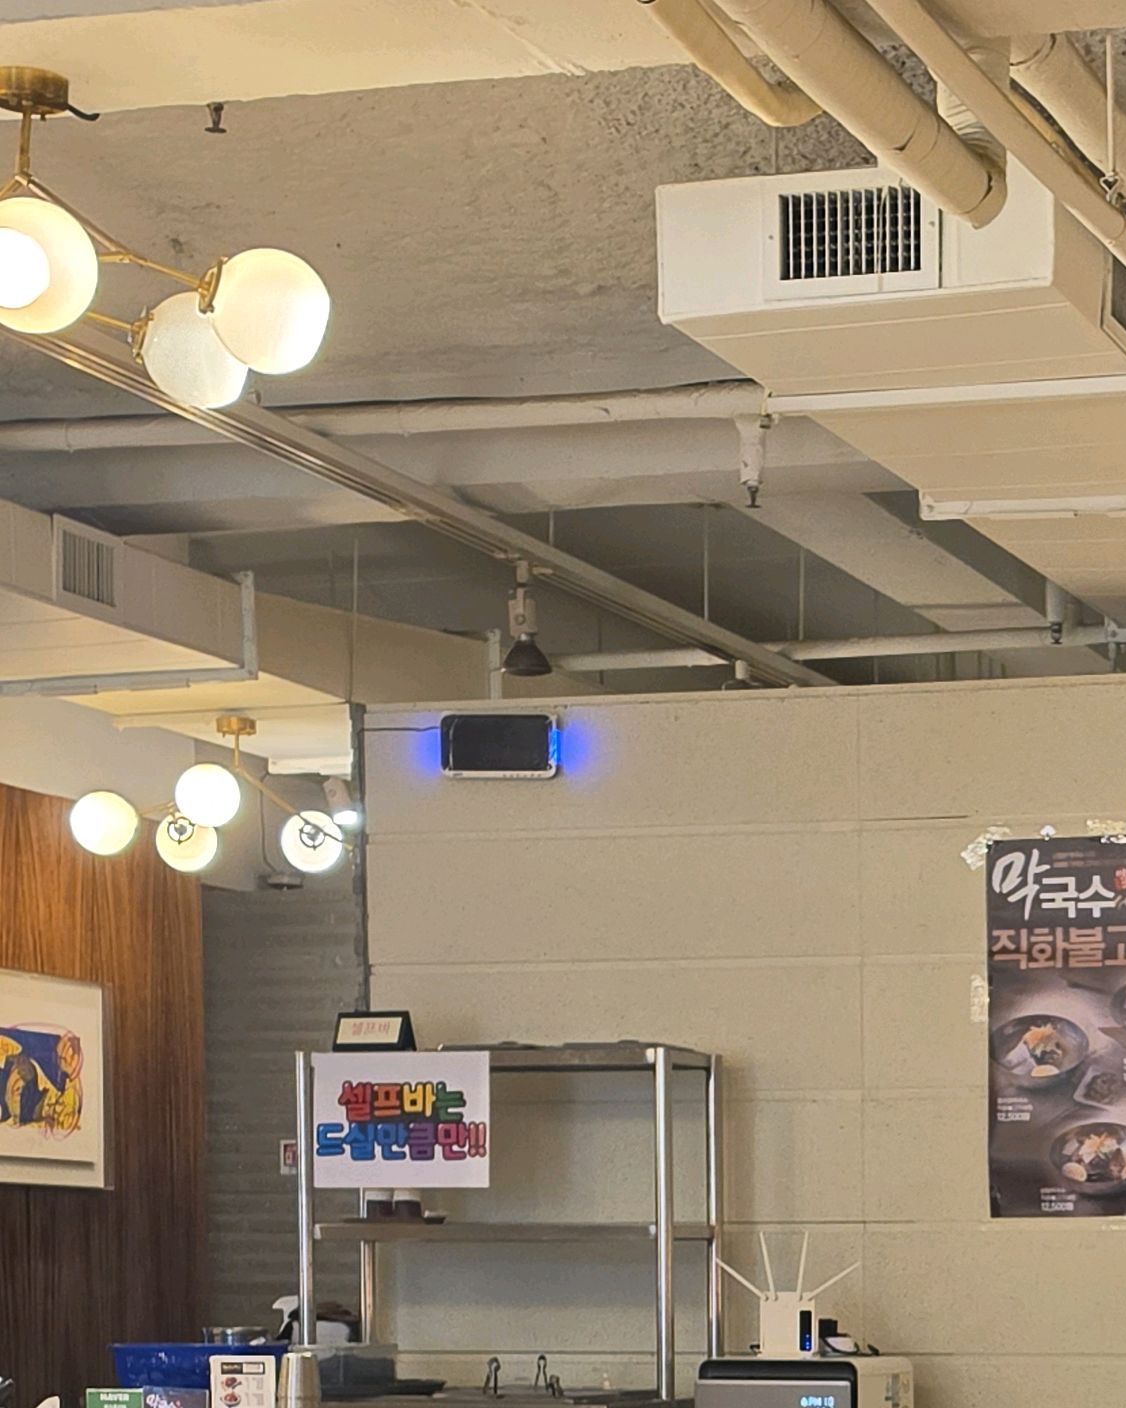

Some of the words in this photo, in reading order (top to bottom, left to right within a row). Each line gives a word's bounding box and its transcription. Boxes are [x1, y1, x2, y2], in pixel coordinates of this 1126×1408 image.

[991, 848, 1116, 921] 막국수
[338, 1080, 467, 1122] 셀프바는
[316, 1121, 487, 1161] 드실만큼만!!
